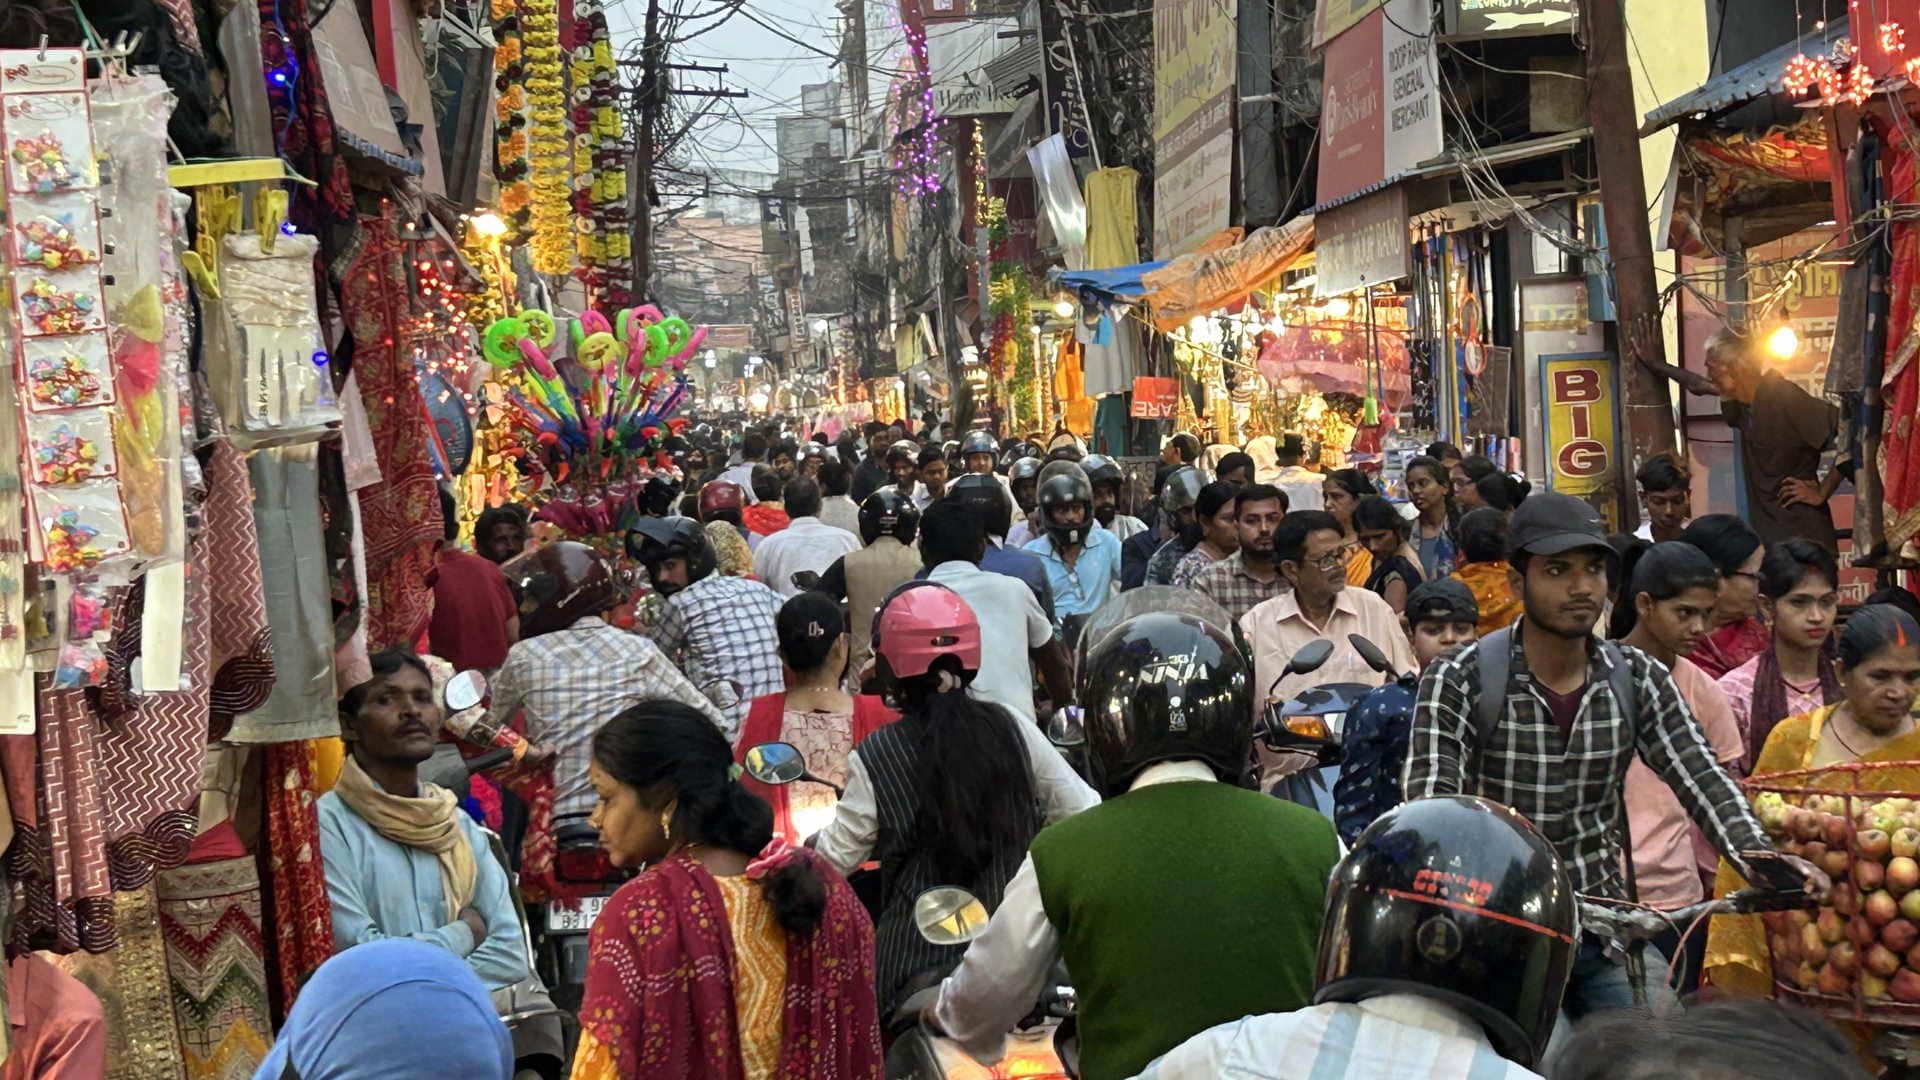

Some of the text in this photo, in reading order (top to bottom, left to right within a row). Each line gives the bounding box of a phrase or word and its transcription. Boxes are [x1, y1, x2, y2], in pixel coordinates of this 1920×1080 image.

[1392, 65, 1425, 101] GENERAL
[1391, 93, 1431, 132] MERCHANT
[1553, 368, 1608, 478] BIG
[1137, 662, 1209, 686] NINJA
